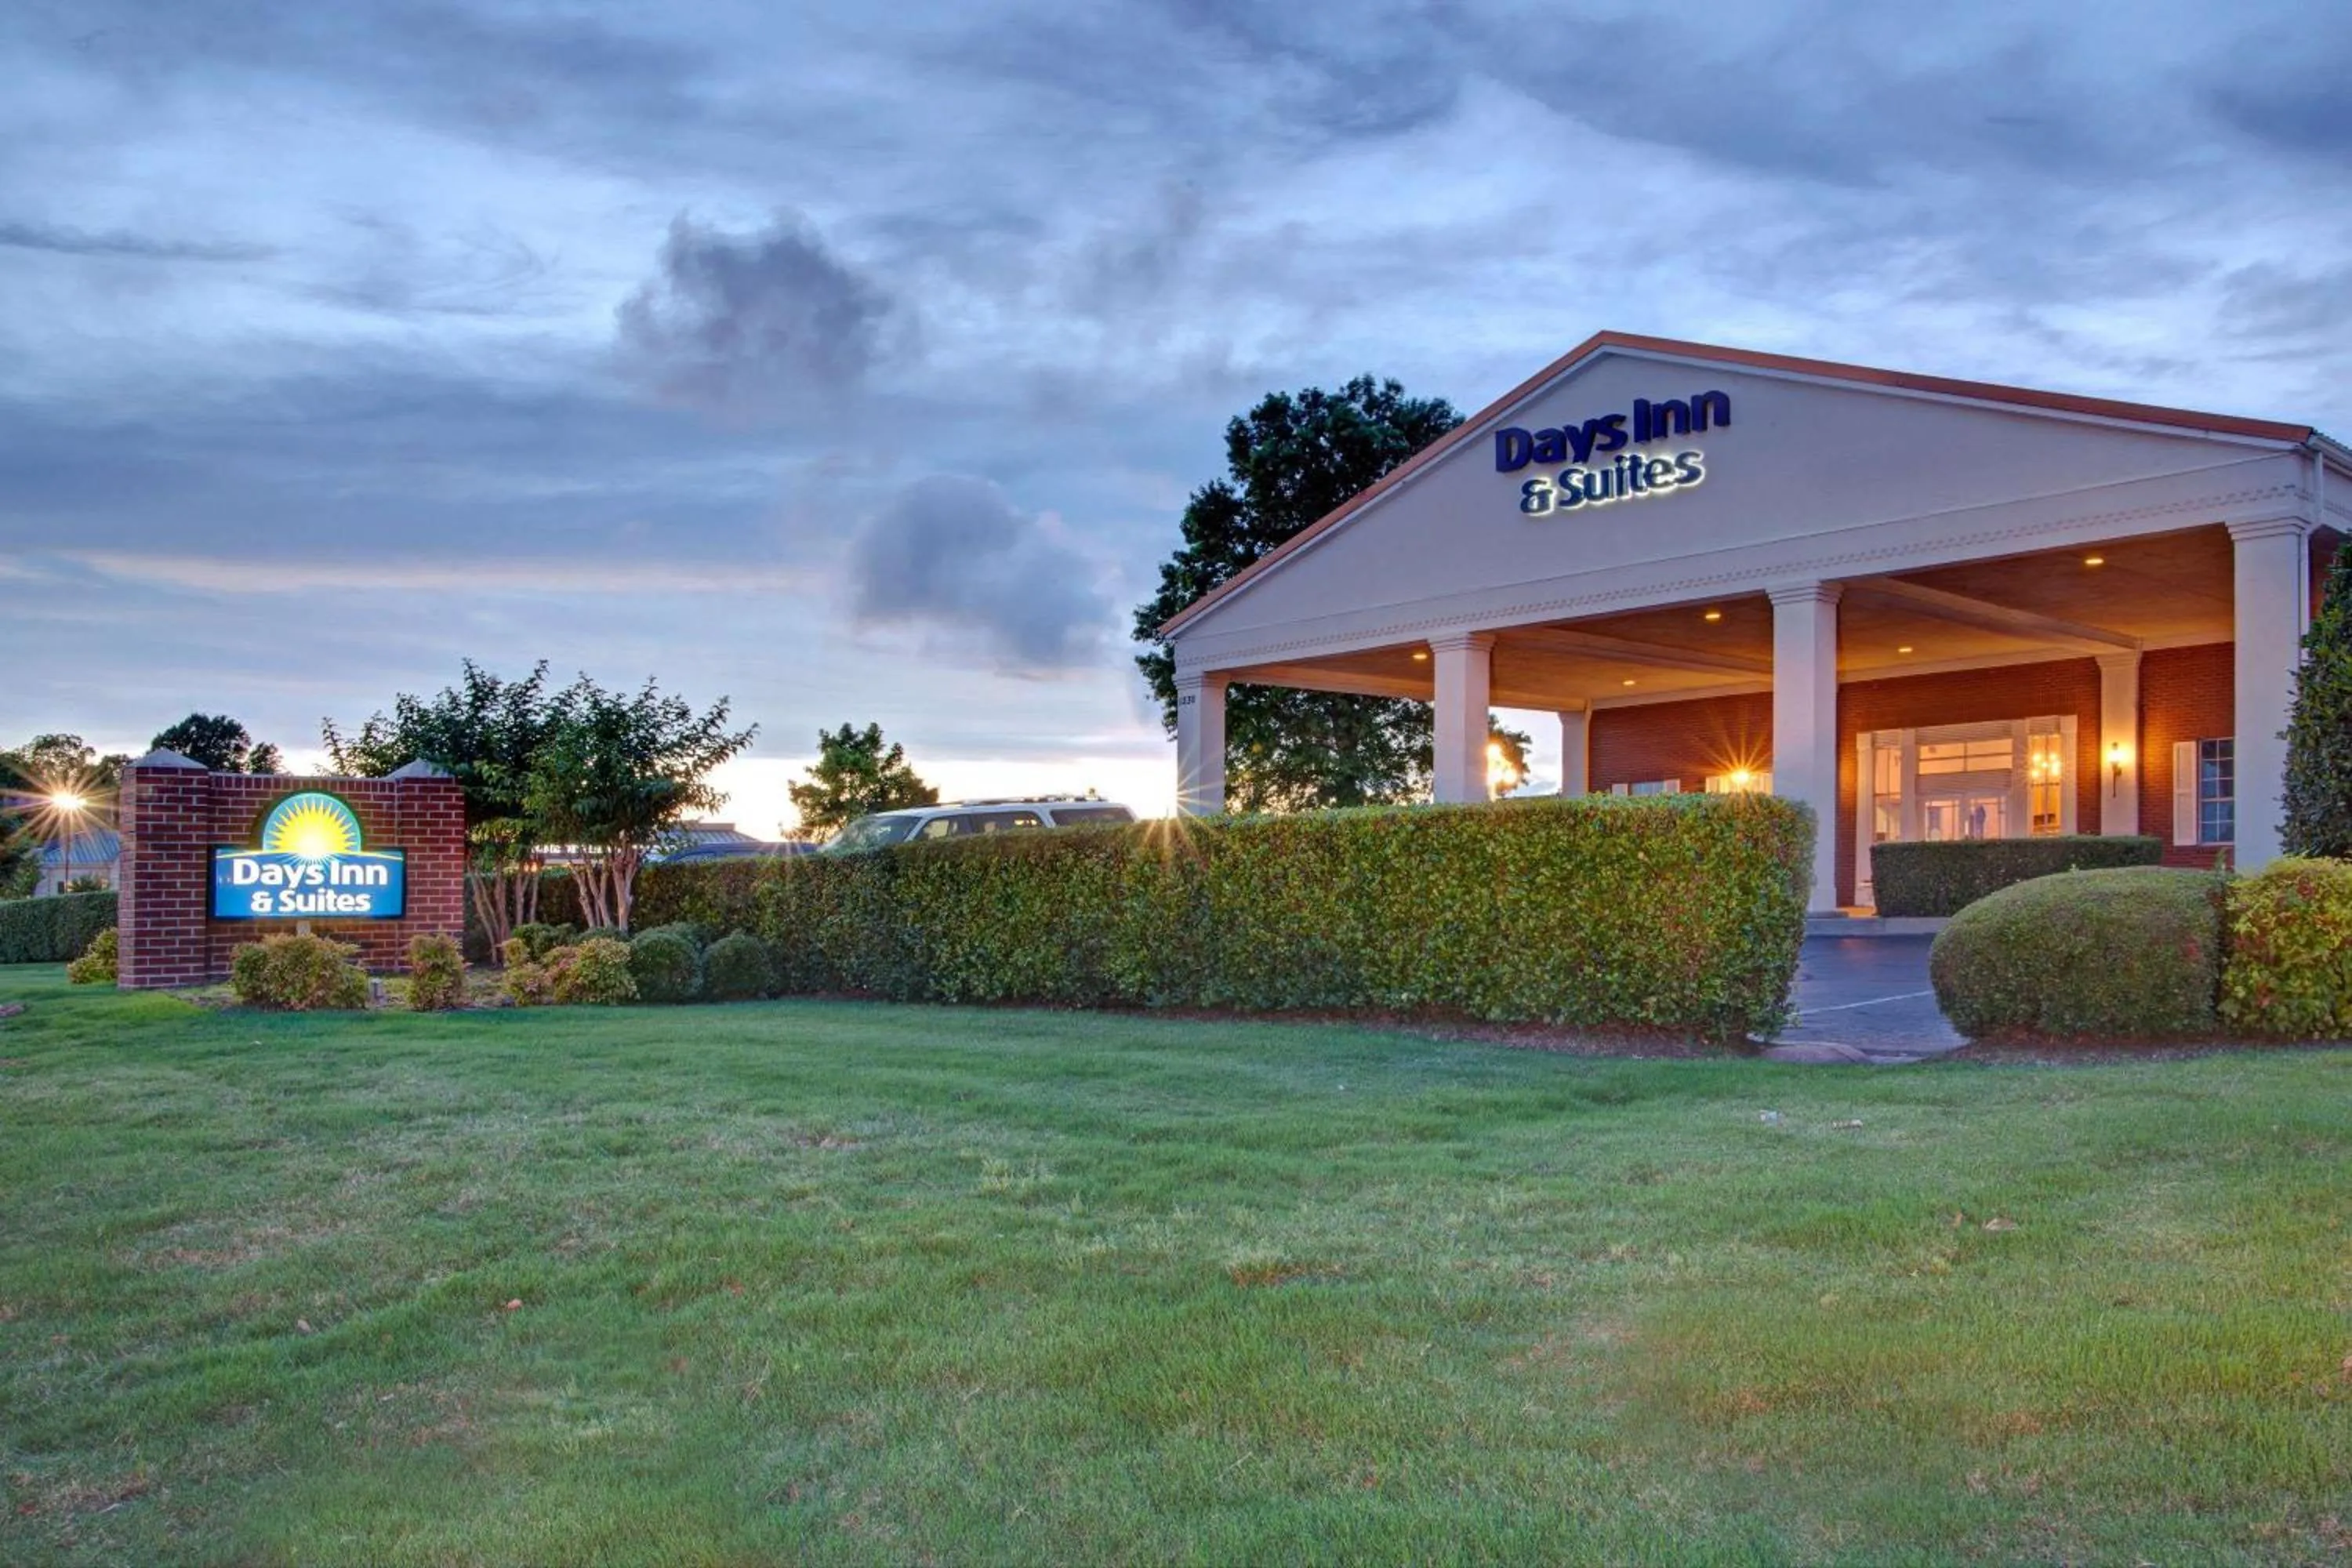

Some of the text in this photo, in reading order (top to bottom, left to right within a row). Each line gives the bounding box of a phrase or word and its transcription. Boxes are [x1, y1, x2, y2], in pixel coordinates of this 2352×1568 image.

[1495, 390, 1731, 472] Days Inn
[1519, 451, 1704, 514] & Suites
[233, 858, 388, 888] Days Inn
[250, 887, 371, 913] & Suites
